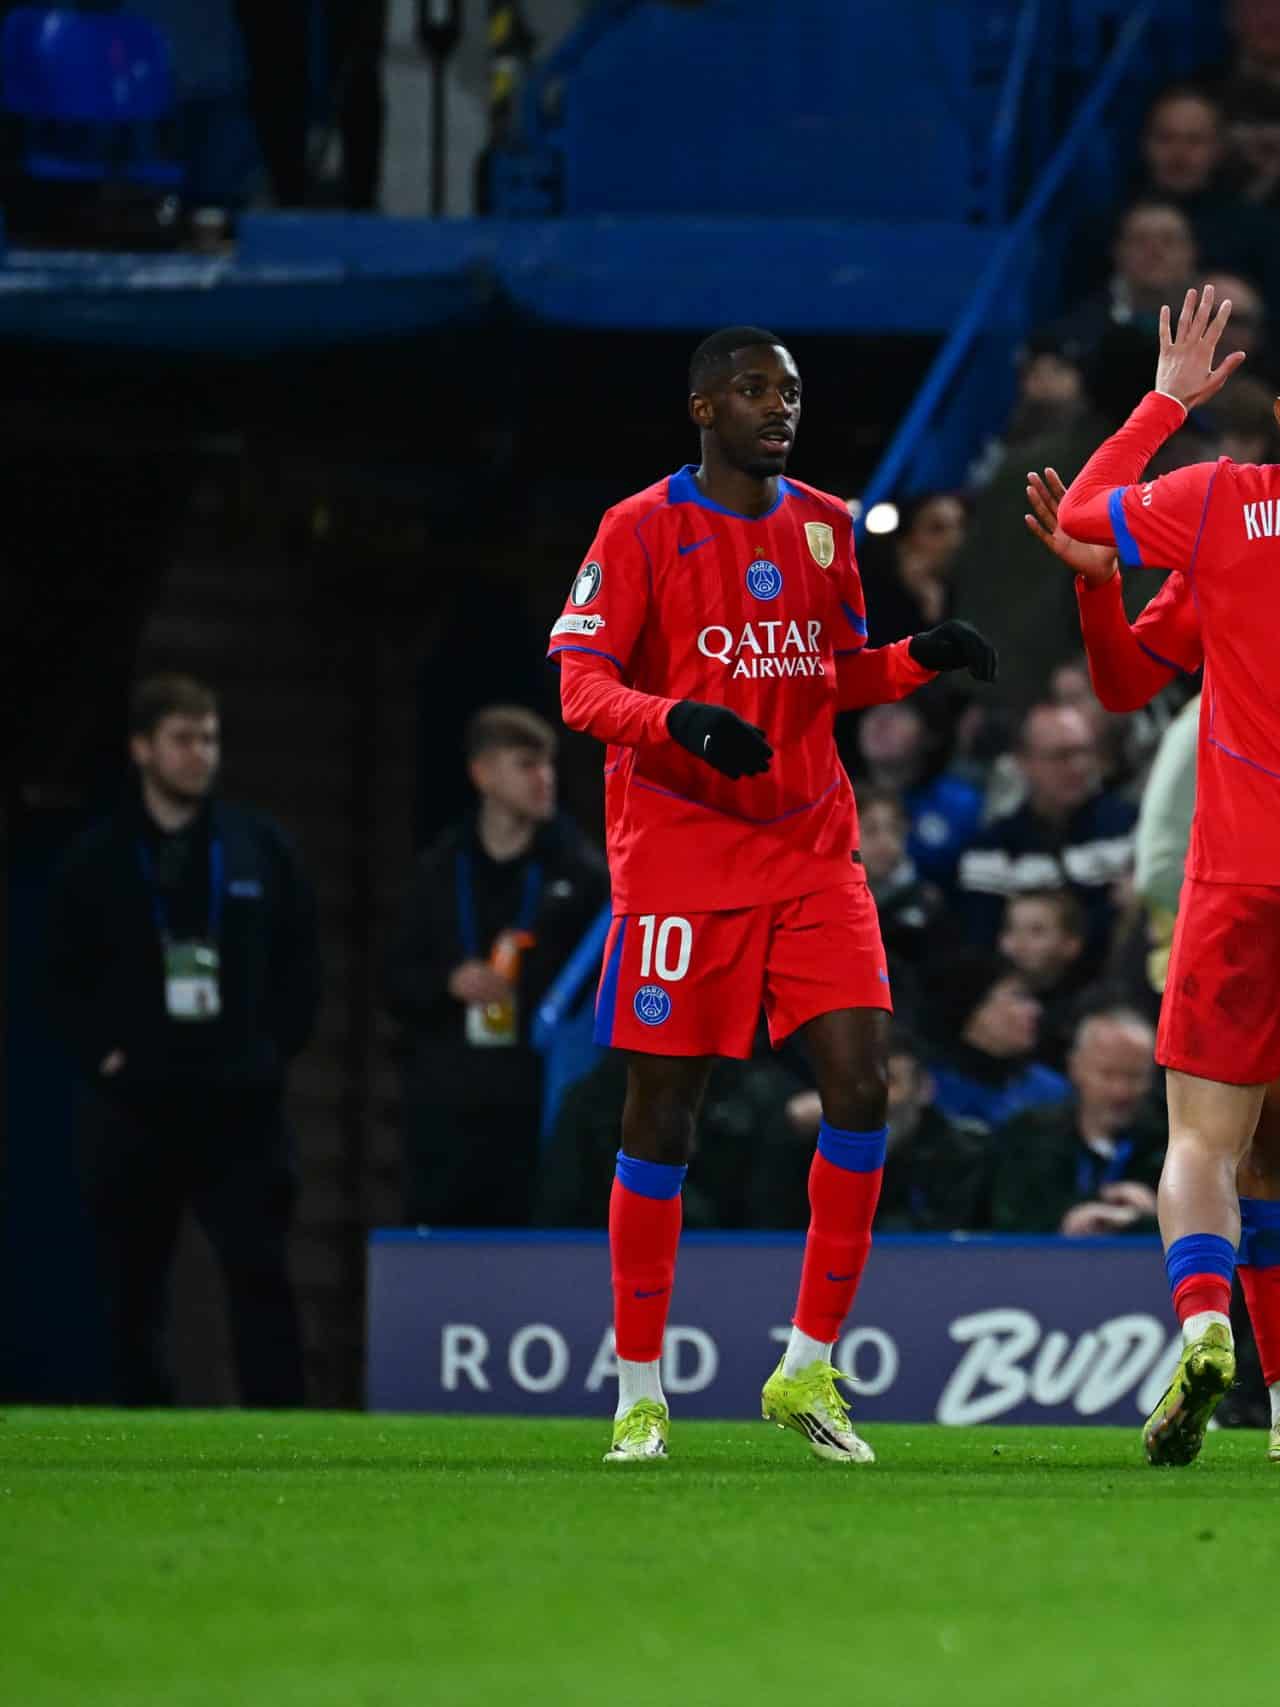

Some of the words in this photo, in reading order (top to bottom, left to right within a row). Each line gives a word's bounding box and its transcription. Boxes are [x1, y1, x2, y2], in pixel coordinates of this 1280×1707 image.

[750, 561, 773, 573] PARIS
[697, 619, 822, 665] QATAR
[732, 656, 825, 680] AIRWAYS
[638, 914, 693, 982] 10
[440, 1323, 719, 1394] ROAD
[769, 1326, 900, 1397] O
